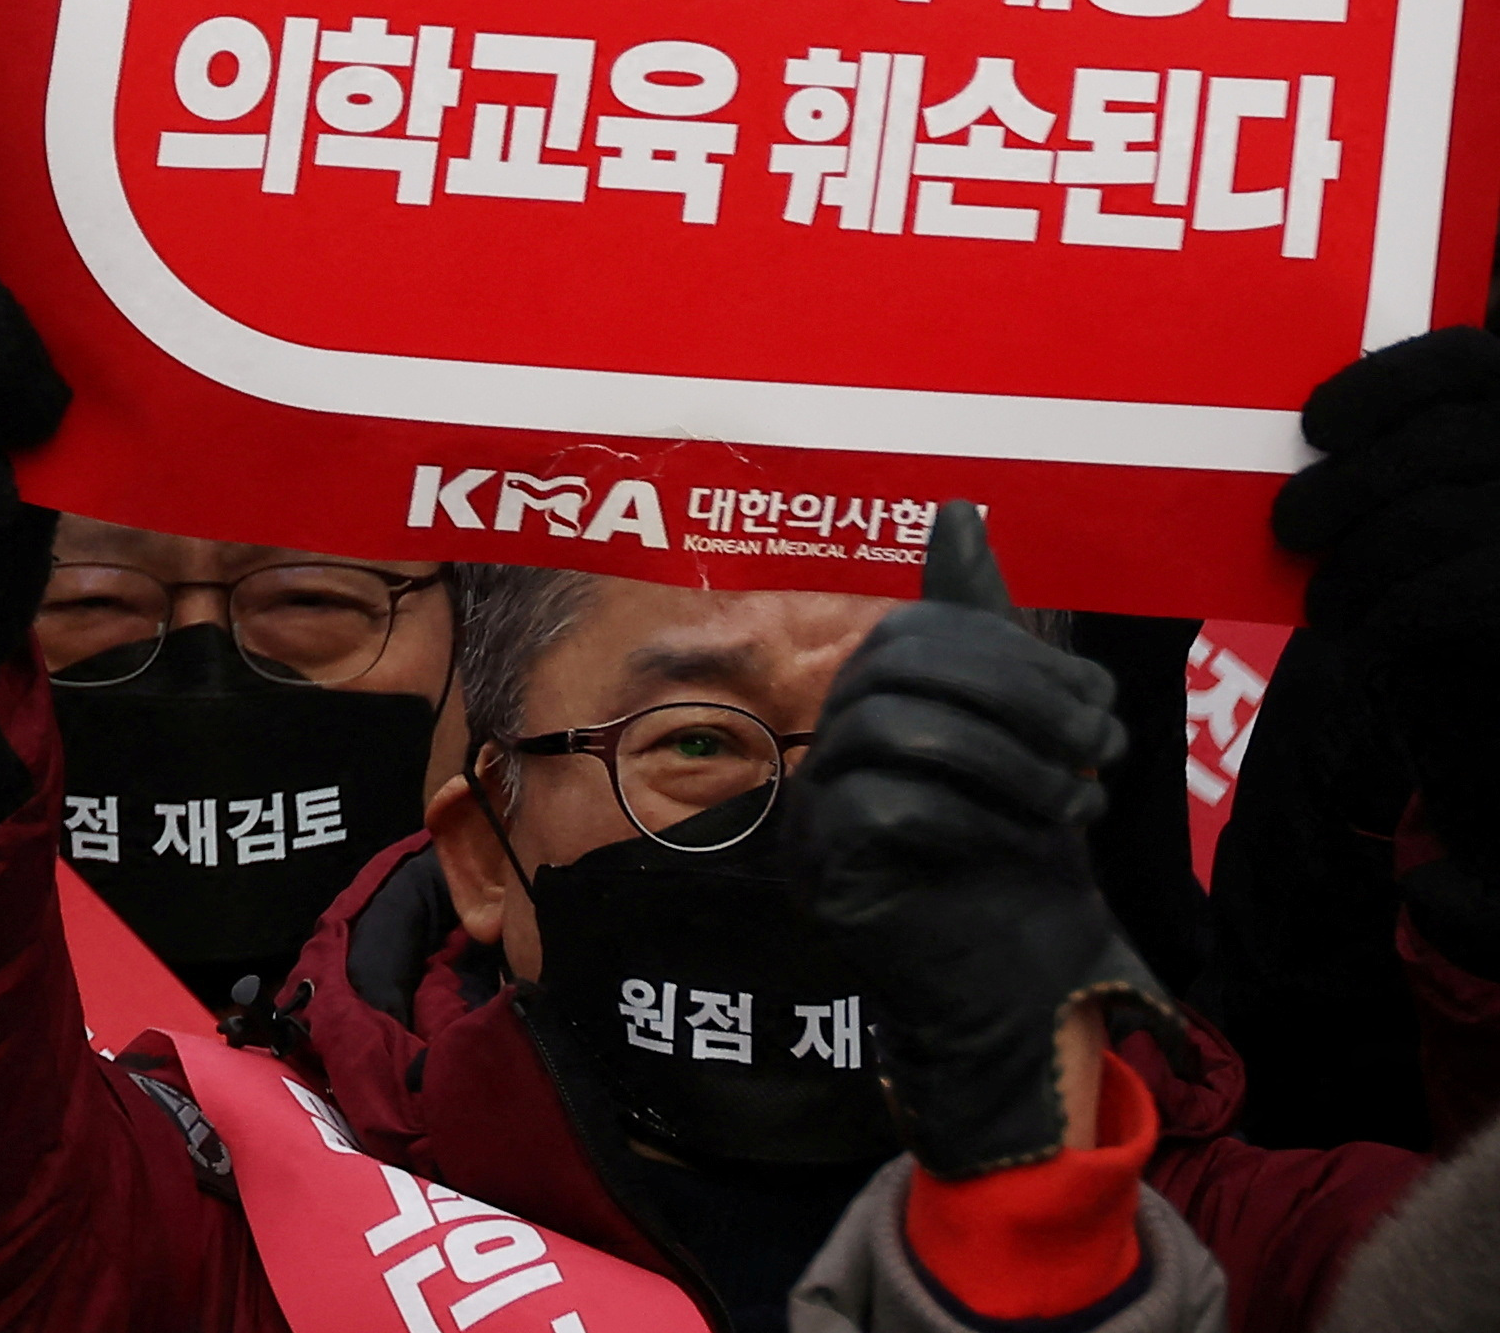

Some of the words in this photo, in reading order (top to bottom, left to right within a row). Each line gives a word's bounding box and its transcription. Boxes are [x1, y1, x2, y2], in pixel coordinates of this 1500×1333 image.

[155, 14, 739, 226] 의학교육
[769, 45, 1342, 260] 훼손된다
[407, 464, 669, 550] KMA
[687, 486, 989, 546] 대한의사협
[62, 792, 122, 865] 점
[151, 785, 349, 868] 재검토
[617, 977, 754, 1066] 원점
